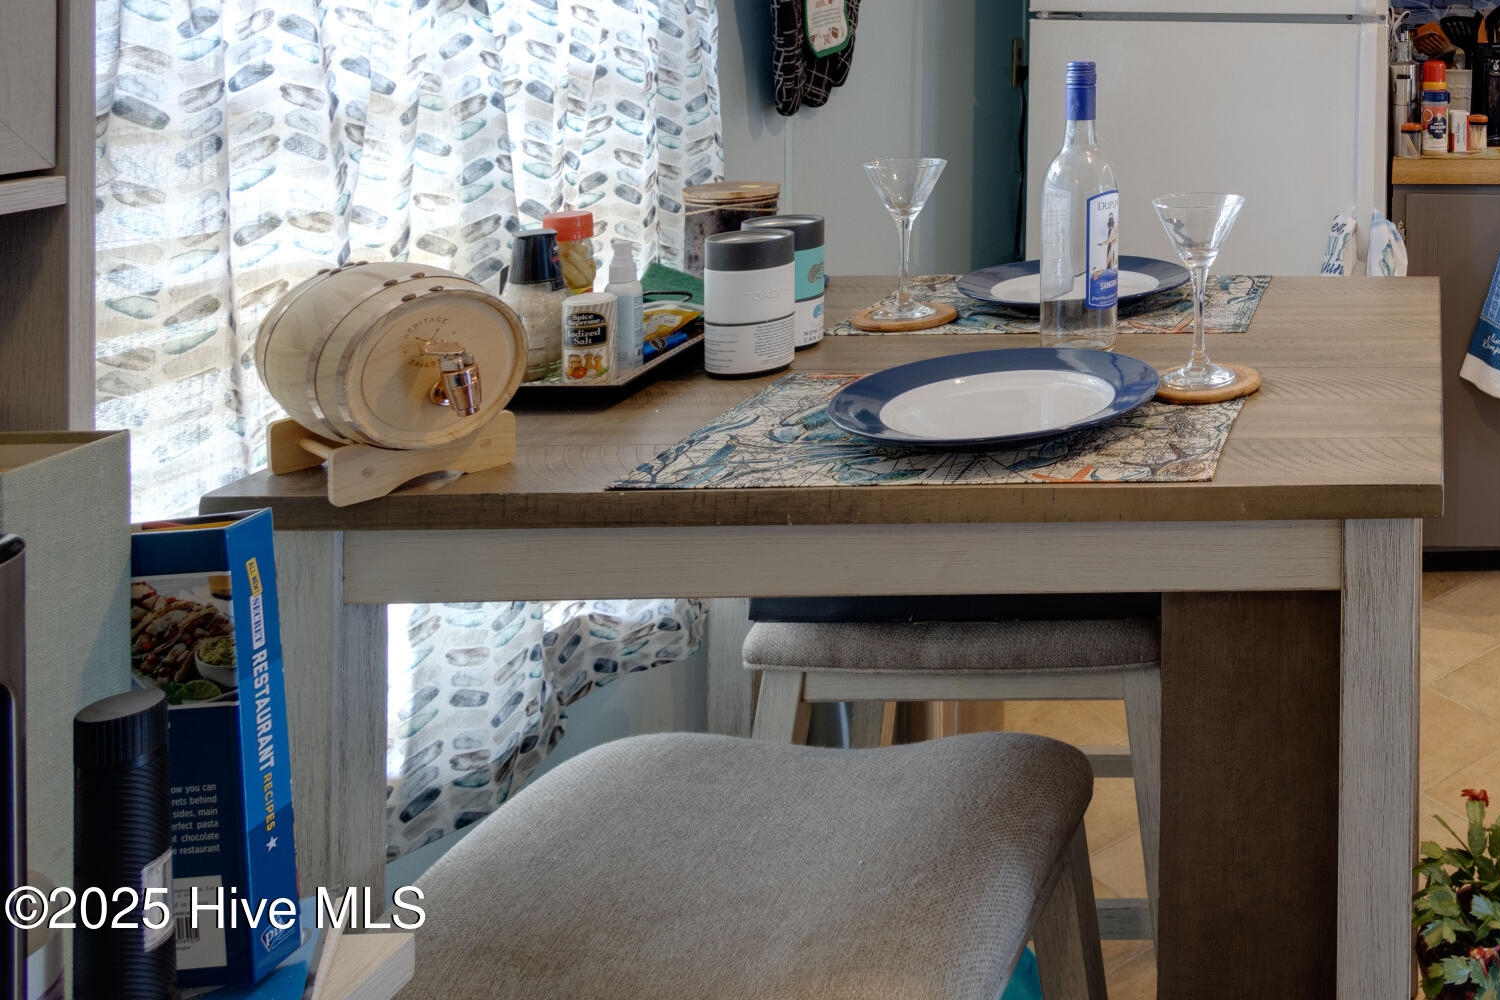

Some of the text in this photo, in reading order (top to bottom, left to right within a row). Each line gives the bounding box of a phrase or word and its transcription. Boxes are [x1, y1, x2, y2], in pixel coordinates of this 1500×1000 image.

[403, 316, 449, 339] HERITAGE
[567, 318, 601, 327] Supreme
[567, 327, 601, 338] Iodized
[573, 337, 593, 345] Salt
[252, 597, 263, 643] SECRET
[252, 649, 275, 772] RESTAURANT
[170, 783, 217, 795] ow you can
[189, 795, 217, 805] behind
[263, 771, 277, 832] RECIPES
[198, 807, 218, 817] main
[196, 820, 219, 830] pasta
[181, 832, 220, 843] chocolate
[179, 844, 221, 855] restaurant
